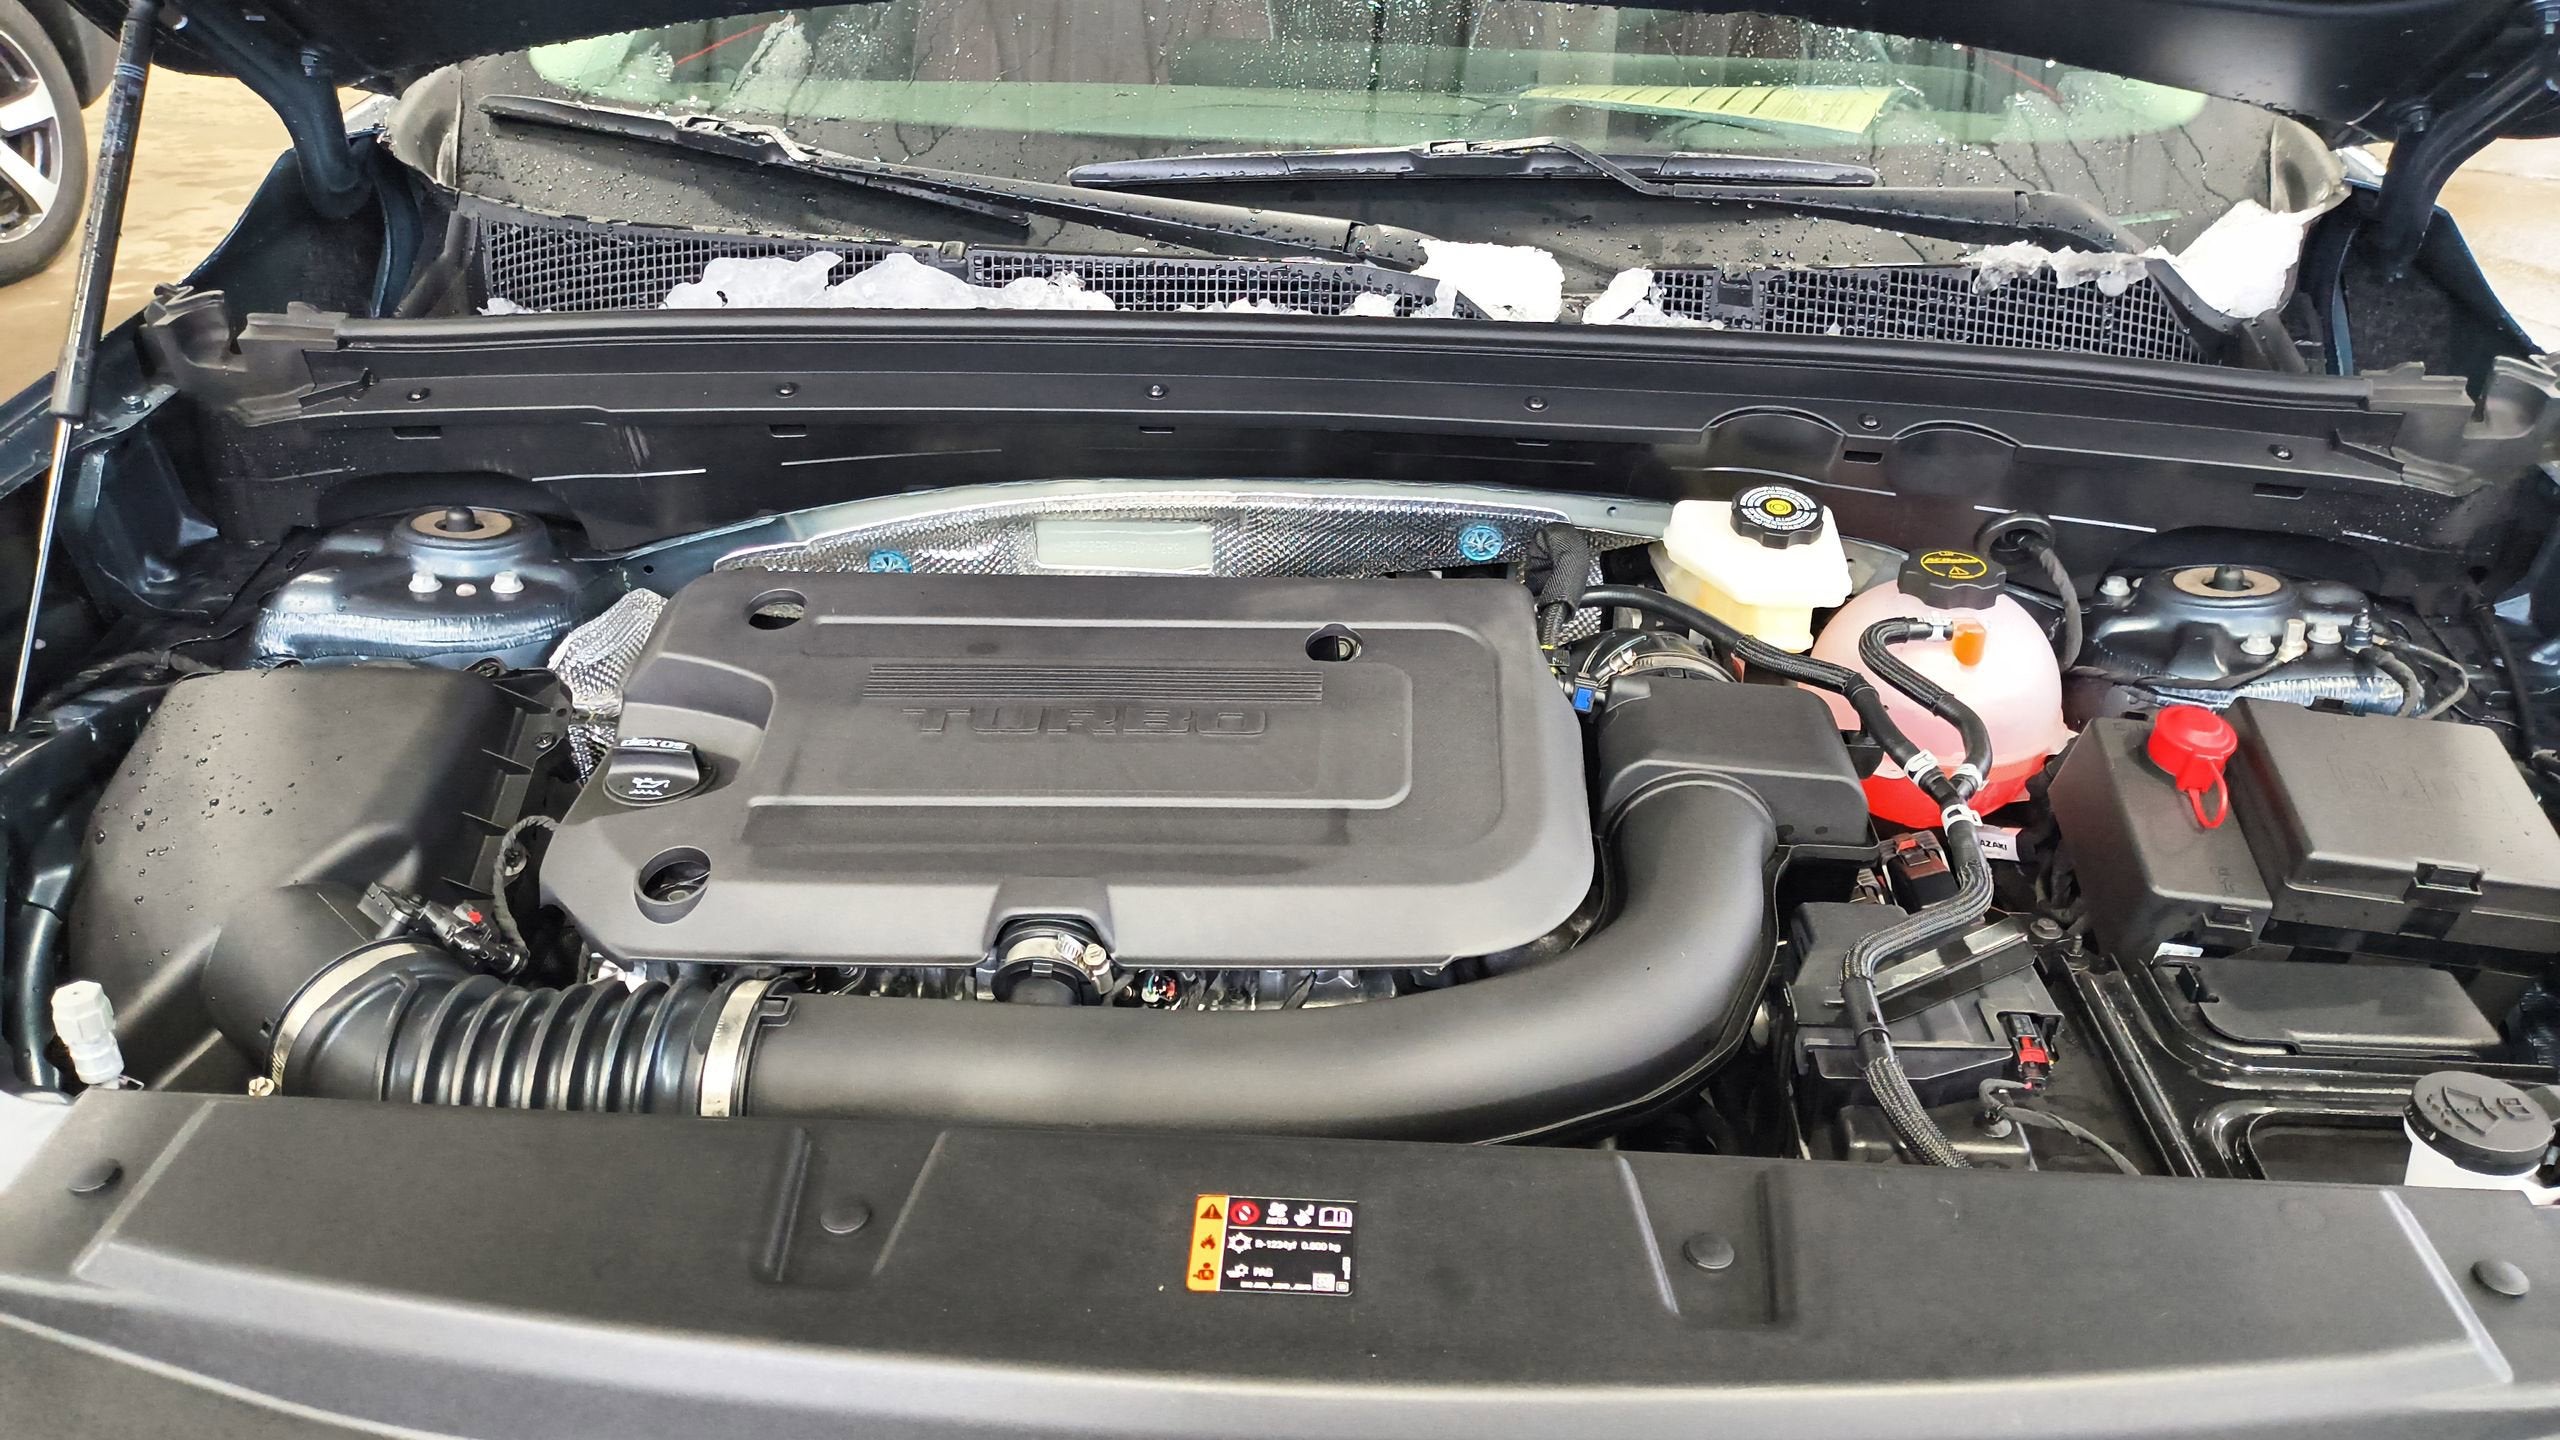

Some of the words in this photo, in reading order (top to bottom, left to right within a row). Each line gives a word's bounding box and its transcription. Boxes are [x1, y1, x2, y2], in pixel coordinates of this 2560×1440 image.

[902, 706, 1267, 738] TURBO
[620, 737, 690, 750] dexos
[1980, 839, 2007, 850] AZAKI
